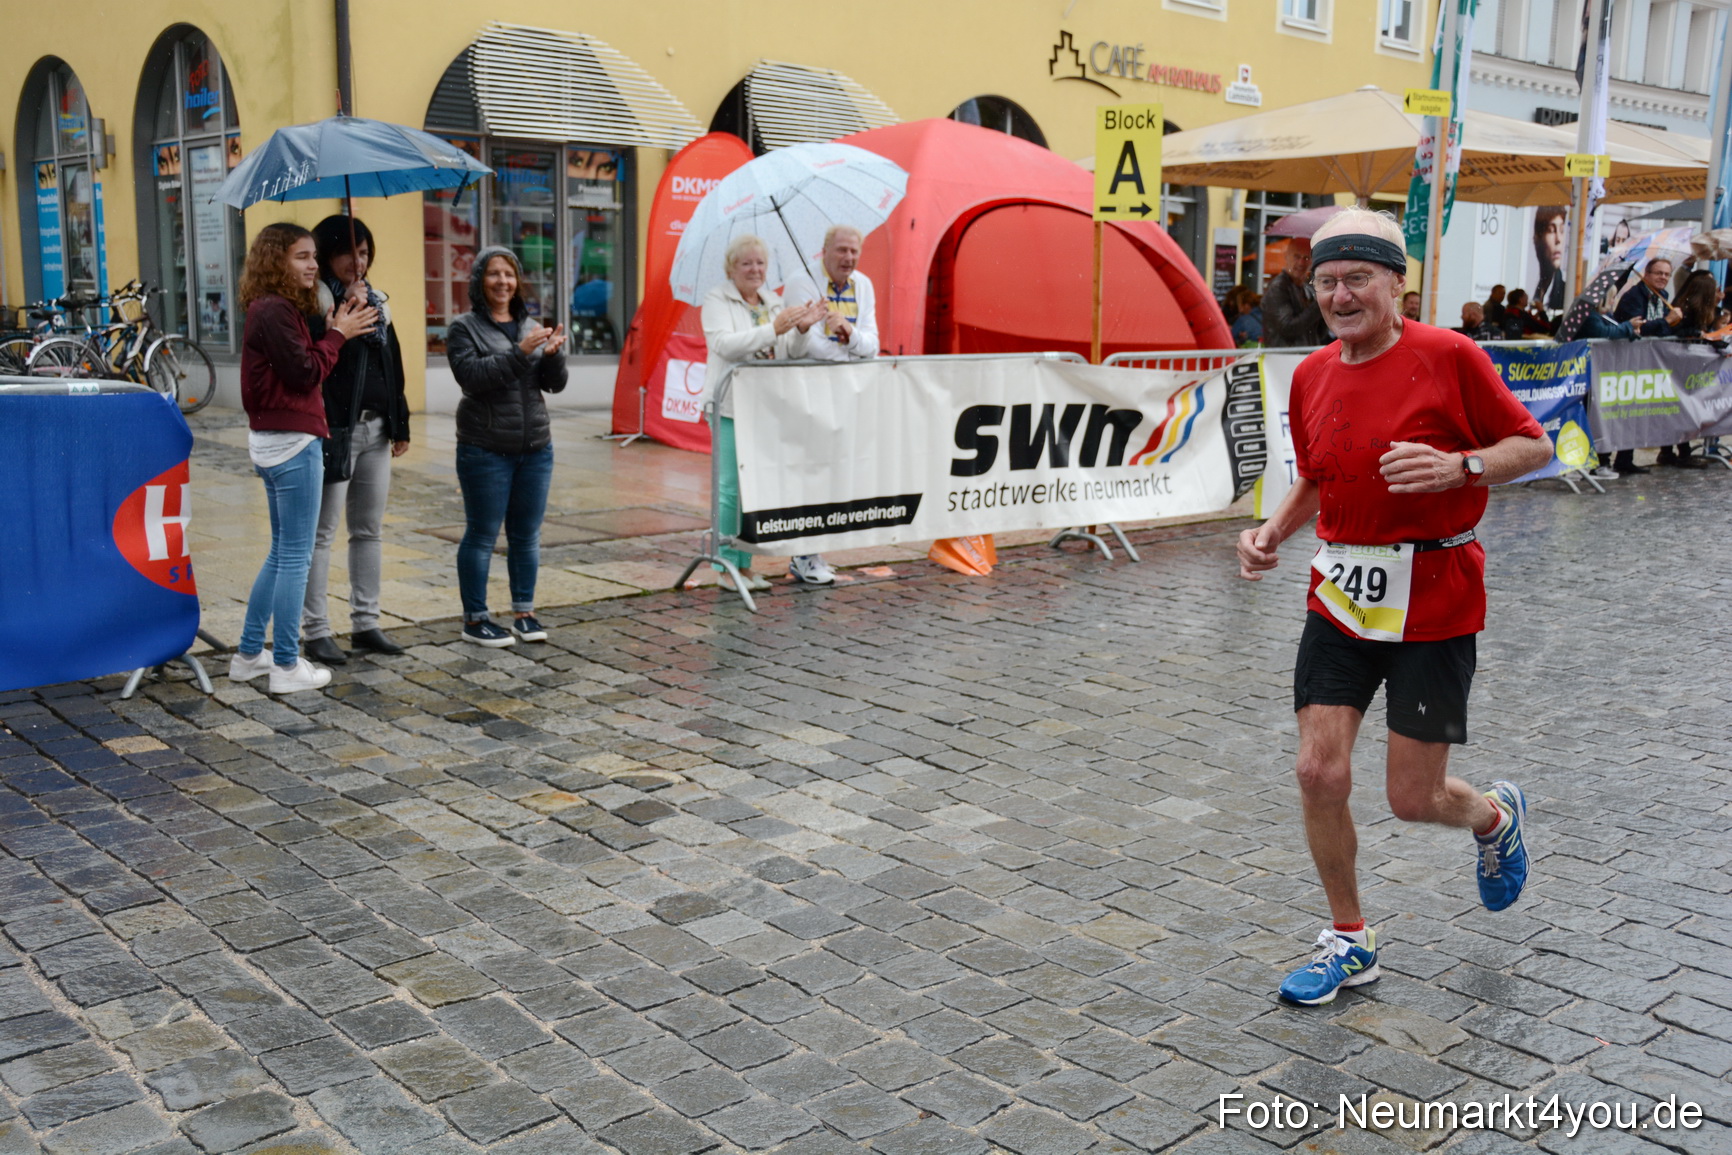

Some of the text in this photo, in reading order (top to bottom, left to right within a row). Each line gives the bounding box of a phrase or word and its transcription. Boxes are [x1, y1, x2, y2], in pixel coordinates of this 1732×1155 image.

[1090, 40, 1145, 81] CAFÉ
[1104, 109, 1156, 130] Block
[1108, 140, 1146, 195] A
[1508, 361, 1558, 382] SUCHEN
[1557, 356, 1587, 378] DICH!
[1511, 382, 1587, 402] USBILDUNGSPLÄTZE
[1600, 369, 1680, 407] BOCK
[666, 397, 699, 416] DKMS
[948, 472, 1173, 512] stadtwerke neumarkt
[756, 505, 906, 535] Leistungen, die verbinden
[1350, 544, 1401, 559] BOCK
[1328, 563, 1388, 603] 249
[1349, 600, 1366, 625] Willi
